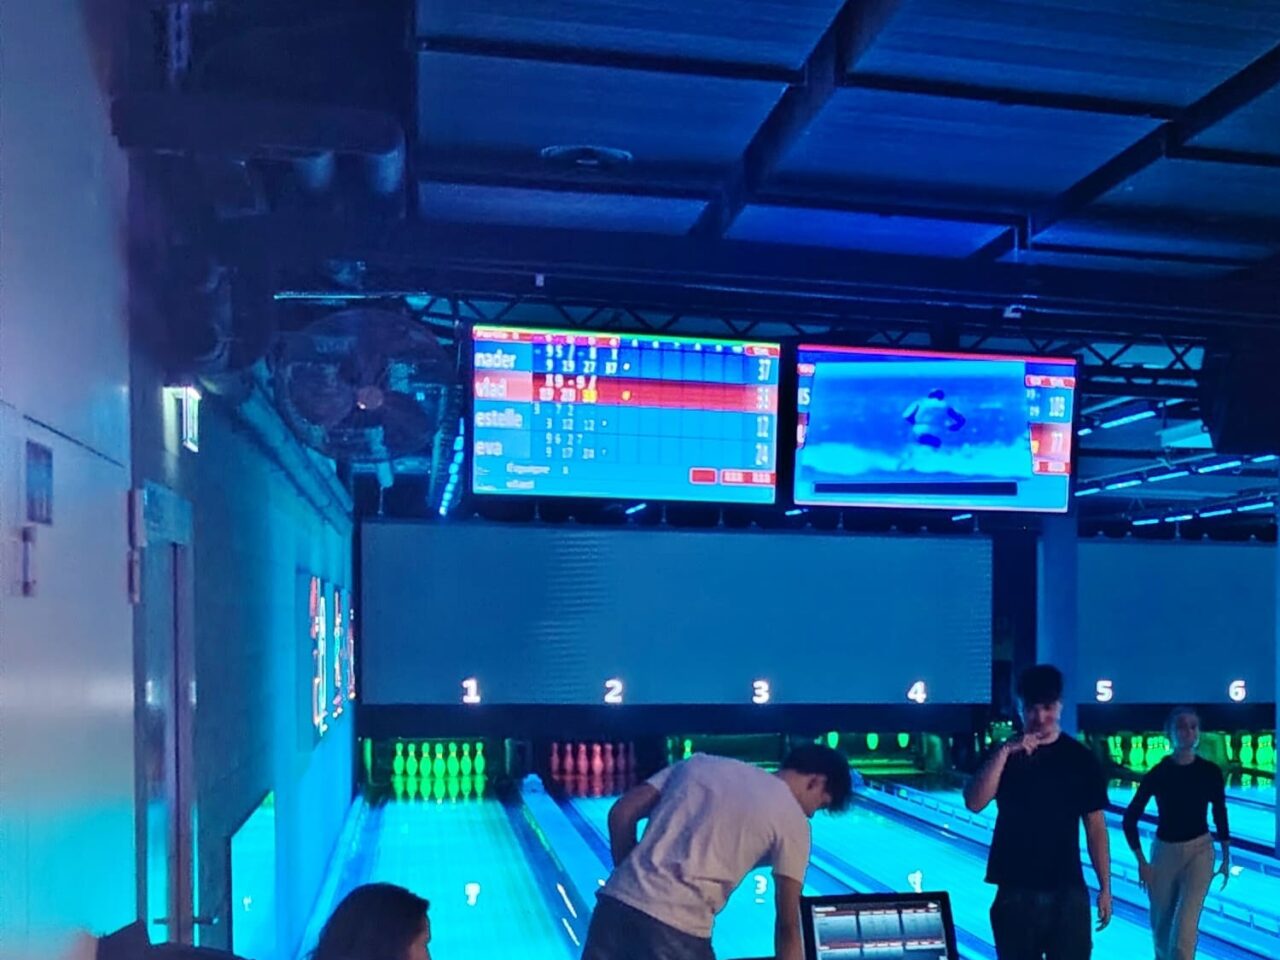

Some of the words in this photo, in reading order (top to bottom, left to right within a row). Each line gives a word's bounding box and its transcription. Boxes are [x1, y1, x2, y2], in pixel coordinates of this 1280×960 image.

[475, 349, 516, 368] nader
[475, 376, 507, 397] vlad
[475, 408, 523, 428] estelle
[475, 441, 502, 456] eva
[463, 677, 481, 703] 1
[604, 679, 623, 703] 2
[752, 680, 770, 704] 3
[907, 680, 927, 704] 4
[1096, 680, 1113, 702] 5
[1229, 680, 1246, 701] 6
